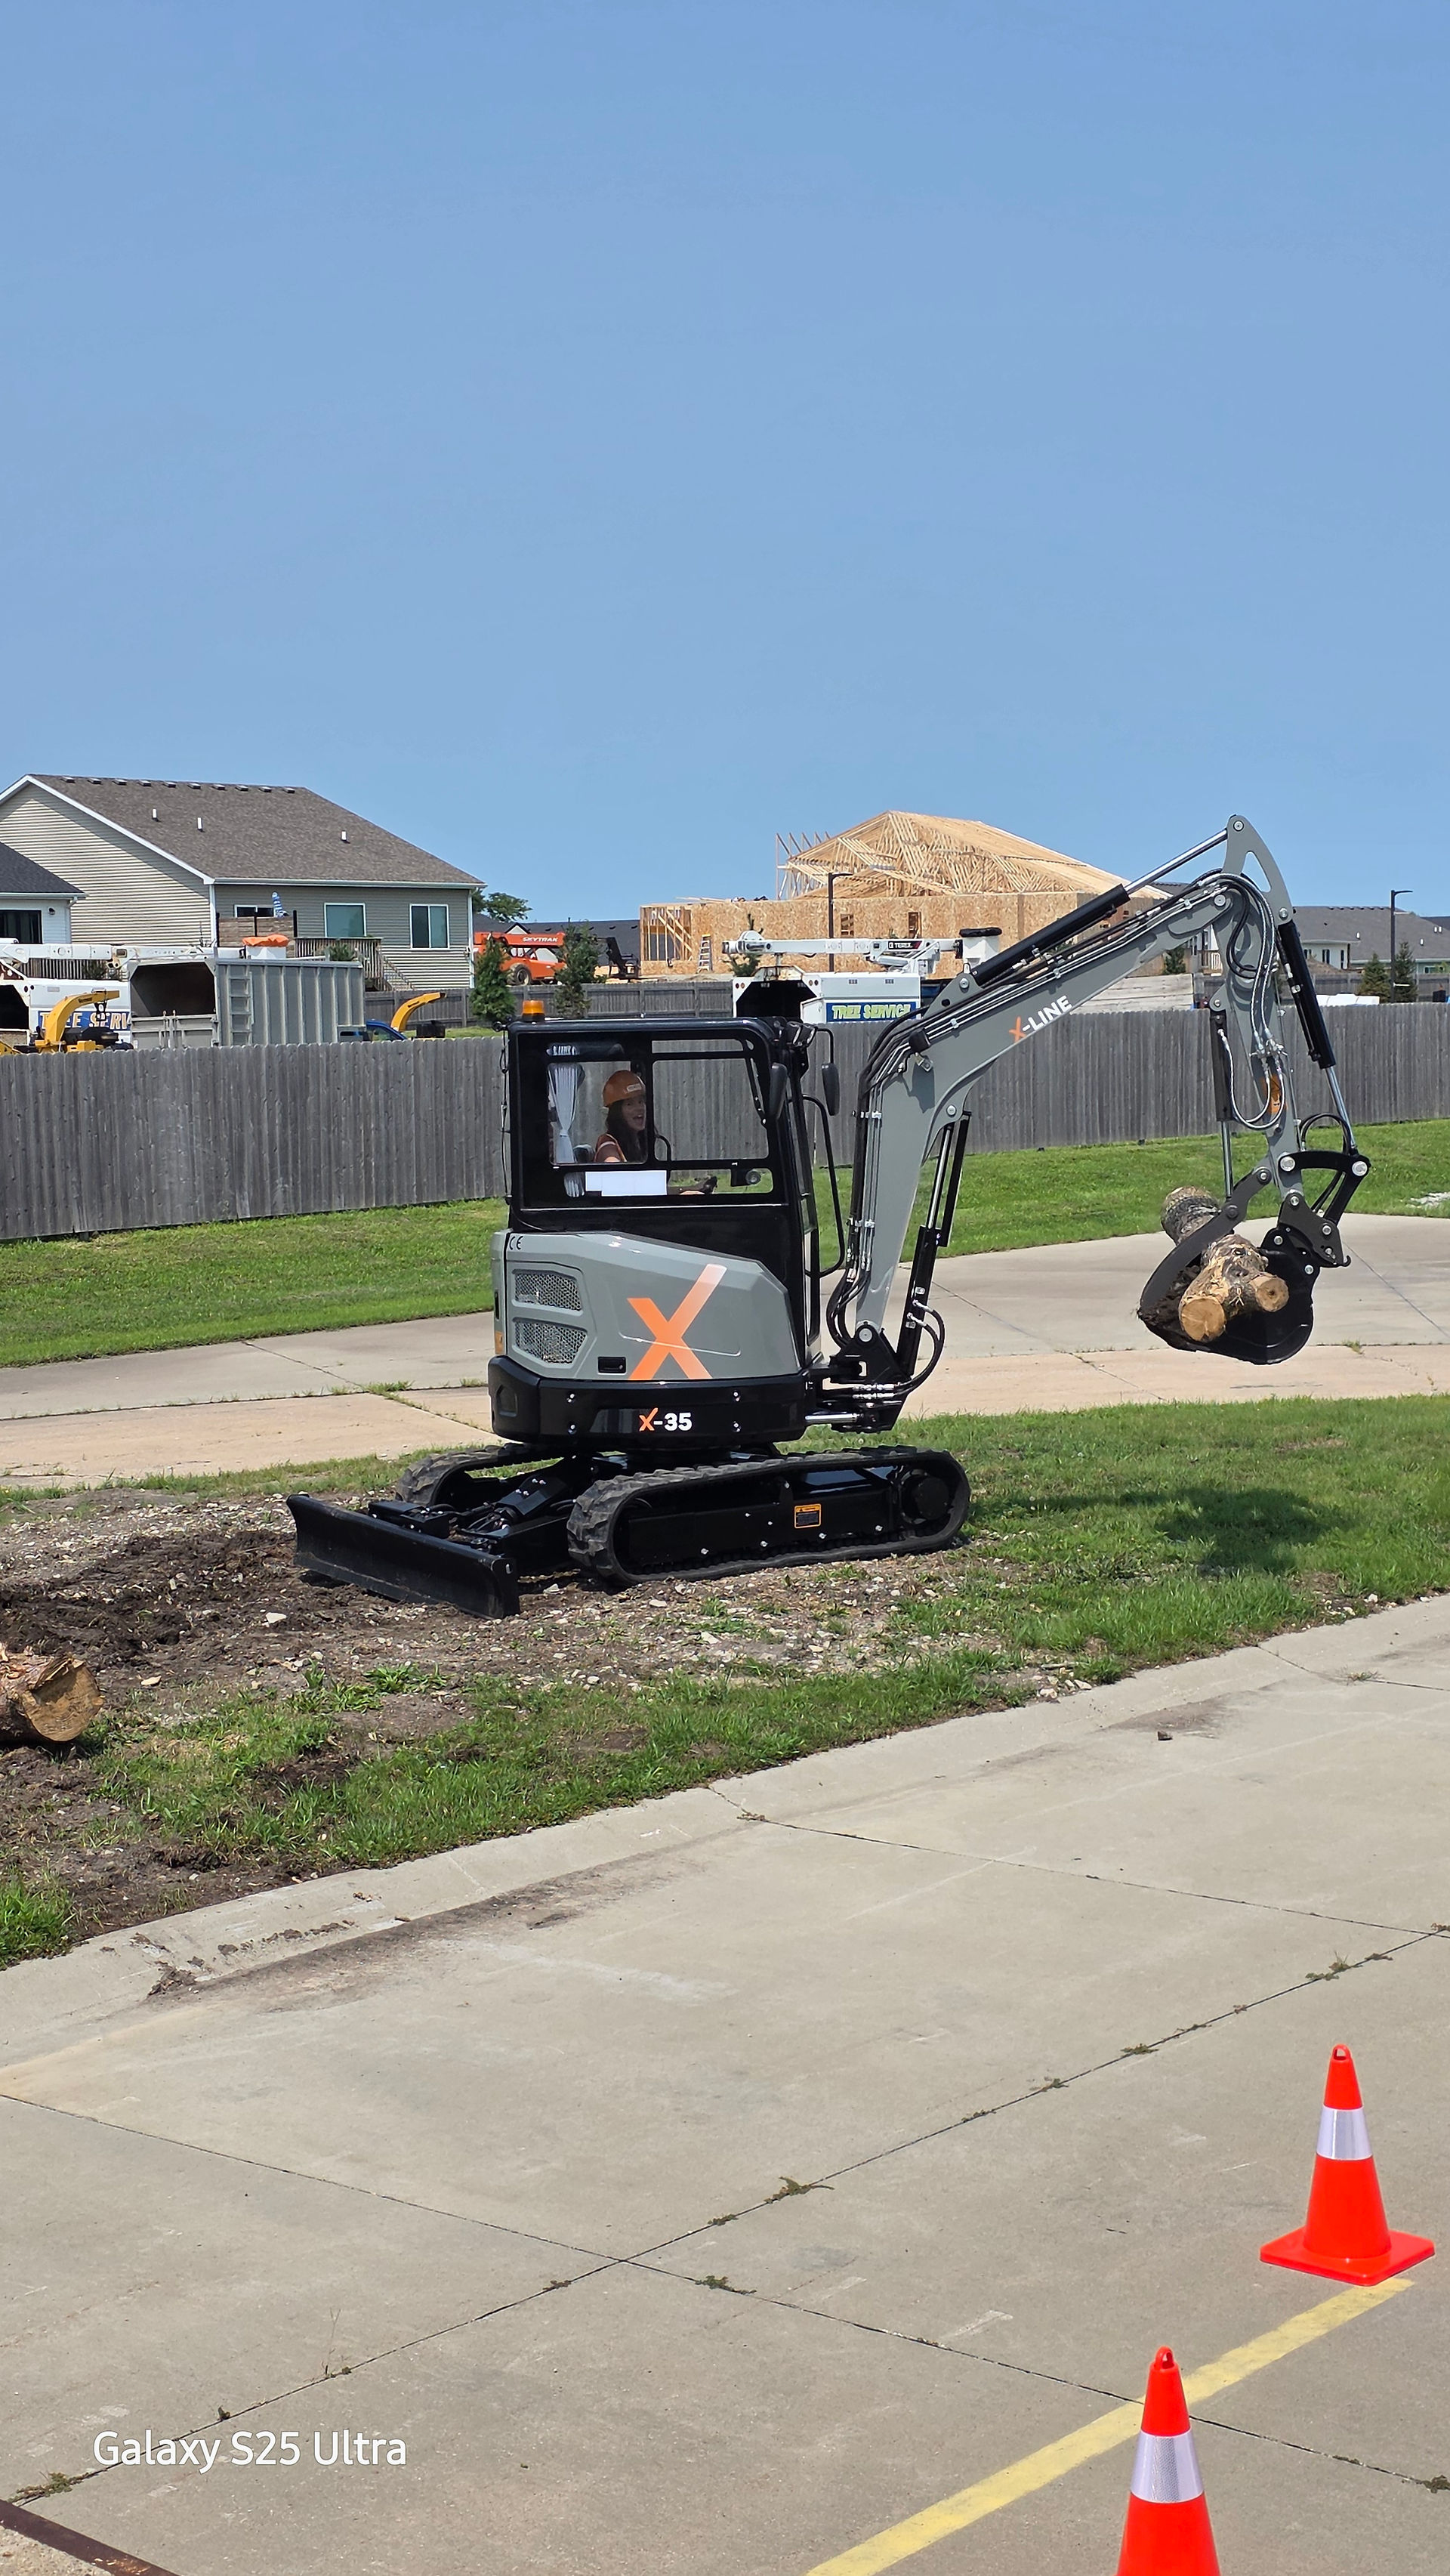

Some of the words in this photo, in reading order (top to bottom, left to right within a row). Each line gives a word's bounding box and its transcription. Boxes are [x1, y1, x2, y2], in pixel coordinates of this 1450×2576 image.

[831, 1005, 861, 1019] TREE
[1008, 995, 1072, 1042] X-LINE
[509, 1235, 523, 1250] CE
[639, 1407, 693, 1432] X-35
